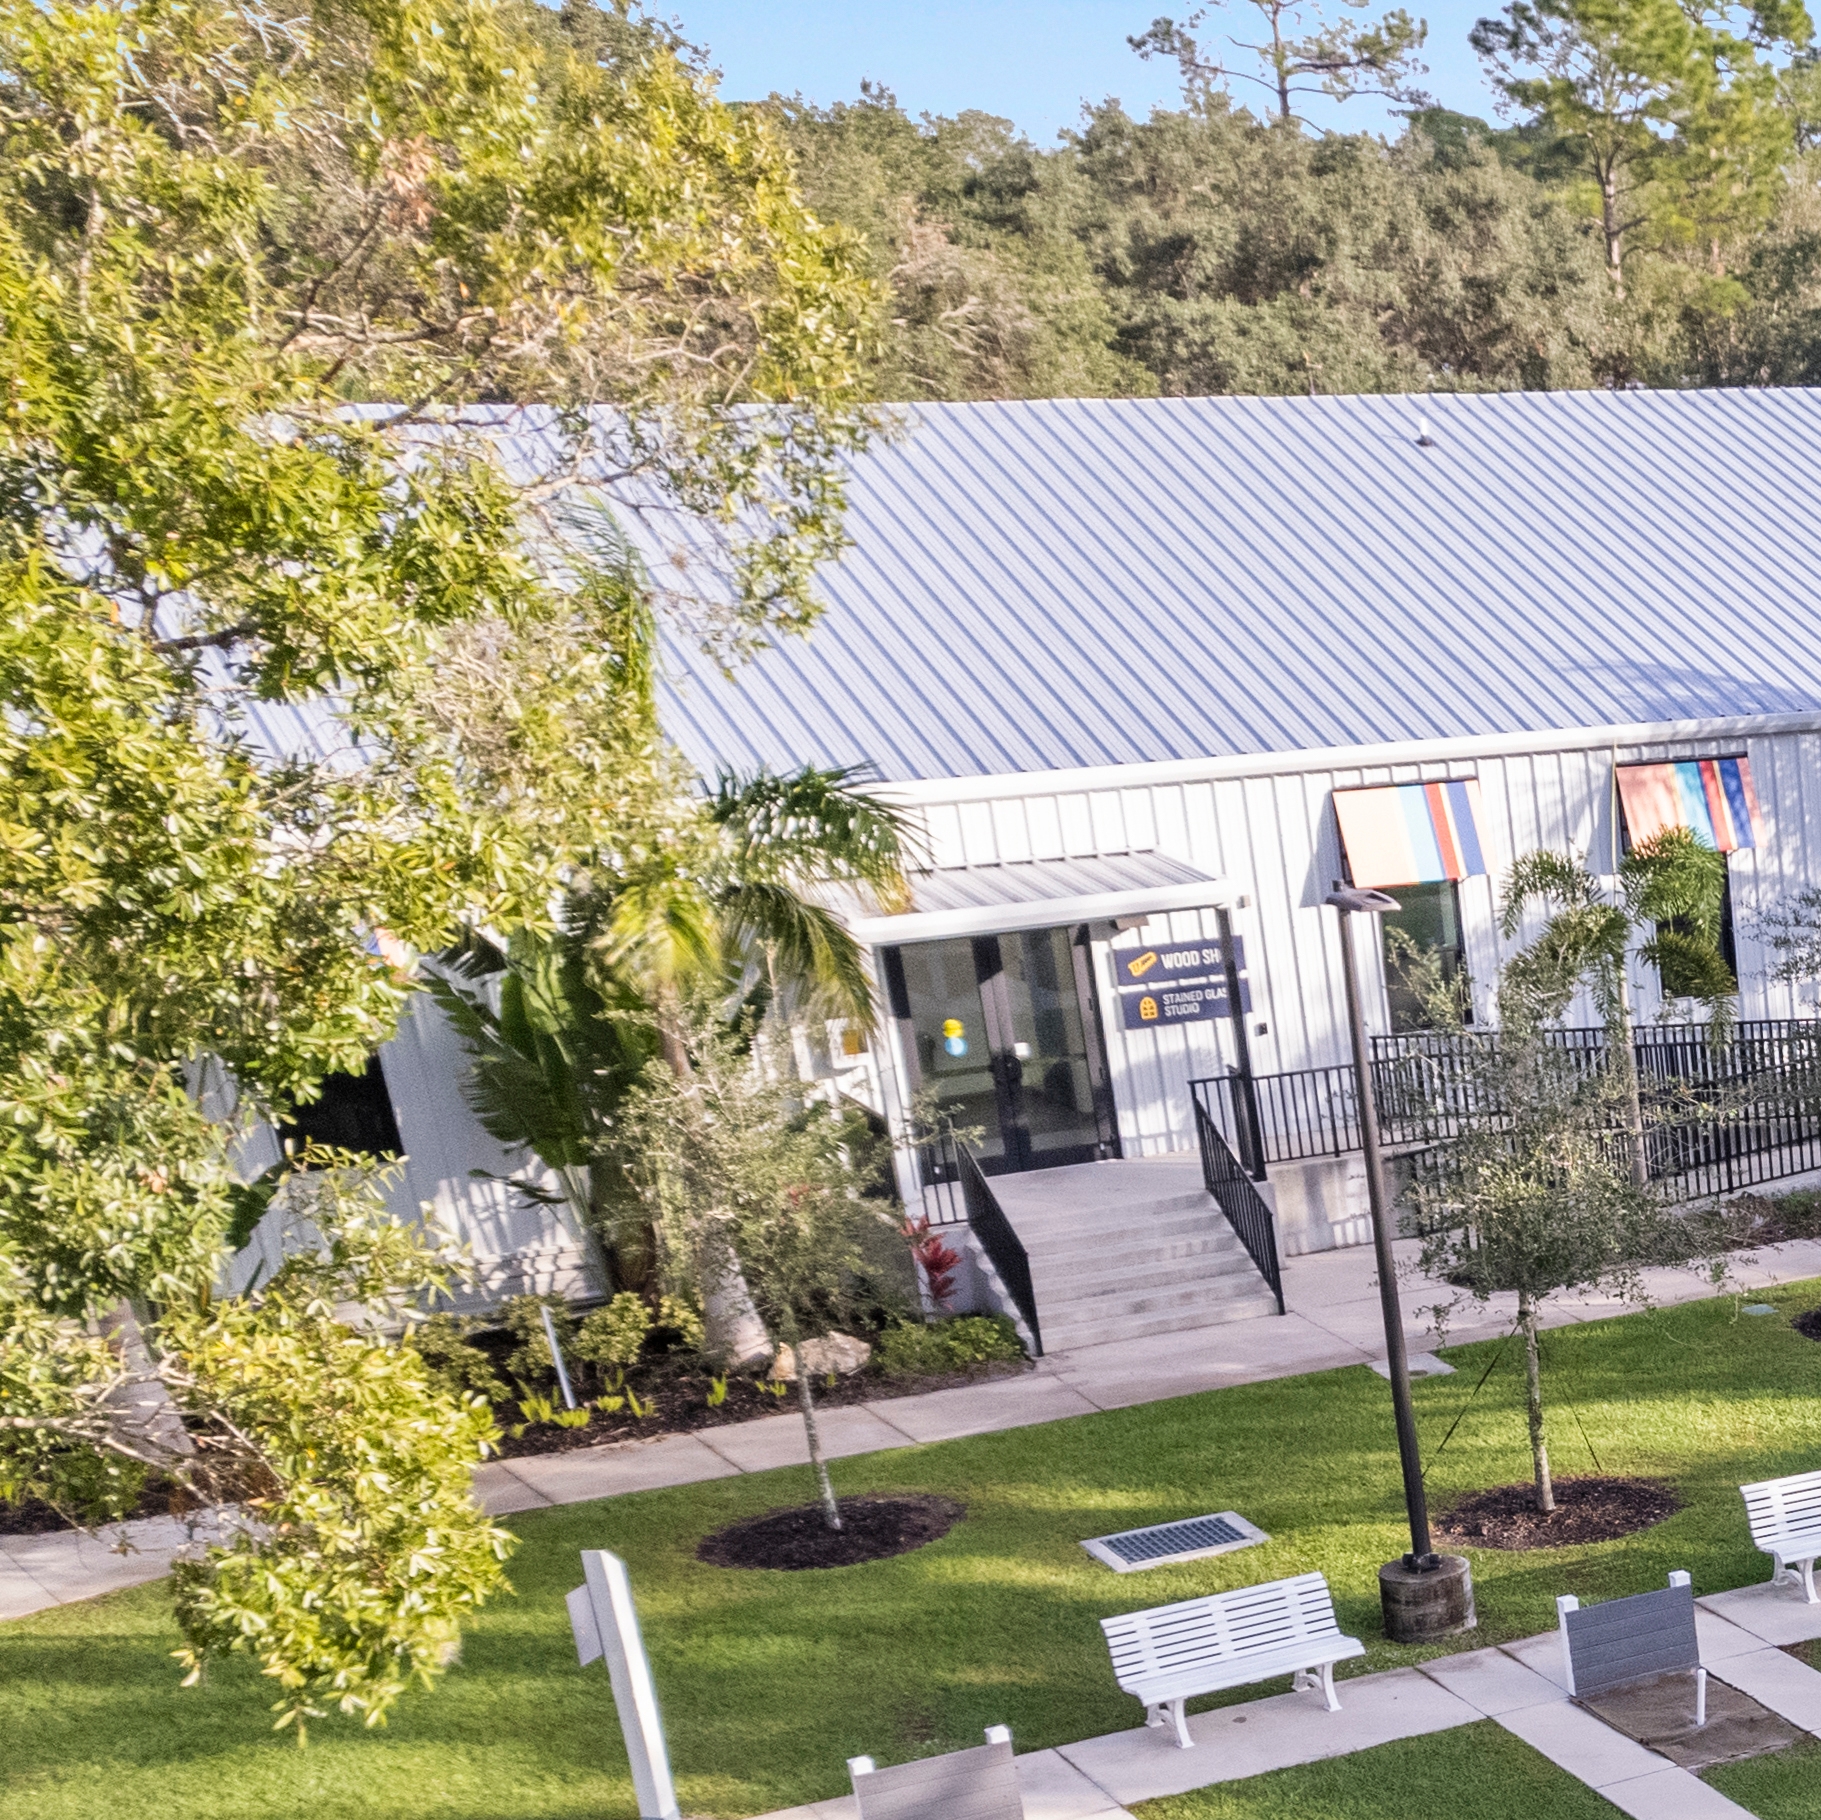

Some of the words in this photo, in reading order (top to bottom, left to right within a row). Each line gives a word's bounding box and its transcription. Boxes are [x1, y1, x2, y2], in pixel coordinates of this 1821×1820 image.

[1160, 950, 1201, 970] WOOD
[1201, 947, 1222, 965] SH
[1162, 989, 1204, 1005] STAINED
[1204, 987, 1228, 1000] GLAS
[1164, 1002, 1201, 1017] STUDIO
